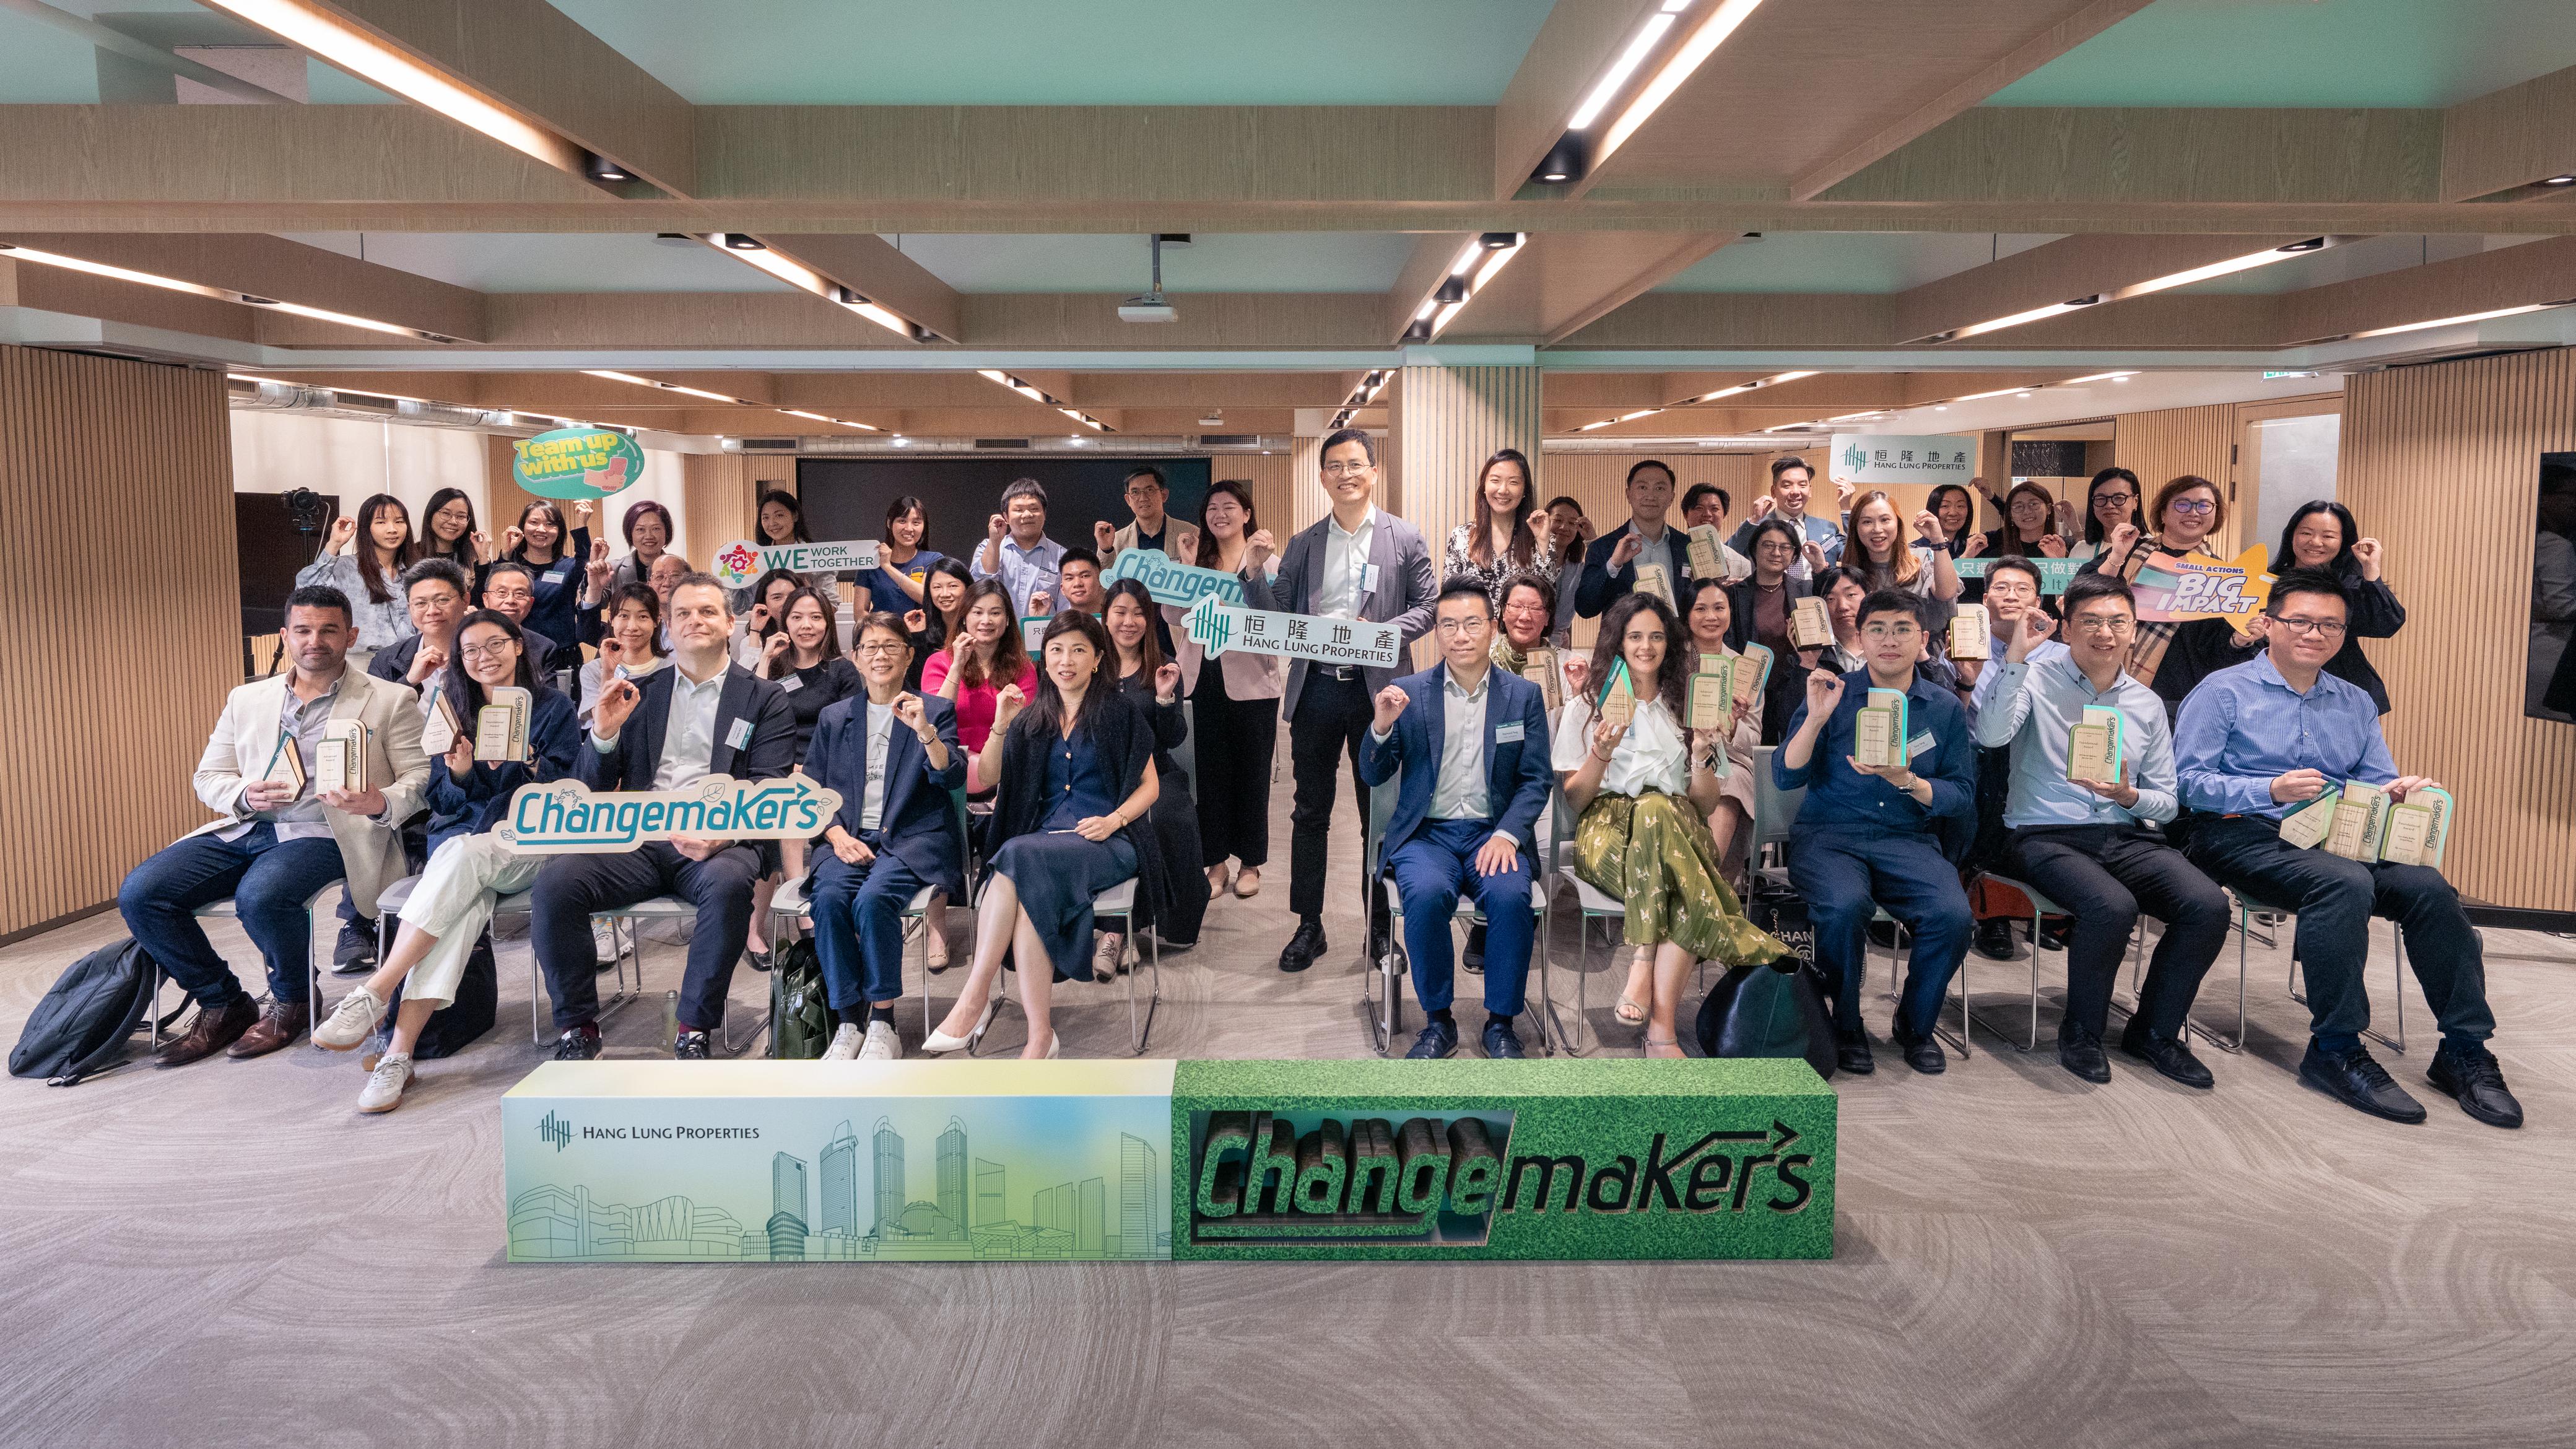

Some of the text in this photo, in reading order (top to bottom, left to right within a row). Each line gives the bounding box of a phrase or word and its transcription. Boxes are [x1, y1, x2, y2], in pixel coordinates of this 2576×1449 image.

[515, 433, 618, 459] Team up
[1874, 450, 1967, 463] 恒隆地產
[518, 452, 609, 476] with us
[1922, 462, 1966, 470] PROPERTIES
[764, 546, 847, 570] WE WORK
[811, 557, 873, 568] TOGETHER
[2175, 562, 2244, 574] SMALL ACTIONS
[2175, 573, 2248, 599] BIG
[2156, 593, 2260, 613] IMPACT
[1244, 614, 1395, 650] 恒隆地產
[1243, 635, 1393, 663] HANG LUNG PROPERTIES
[1718, 664, 1728, 713] Changemakers
[511, 695, 524, 743] Changemakers
[1891, 698, 1900, 748] Changemakers
[349, 728, 359, 775] Changemakers
[2105, 716, 2116, 765] Changemakers
[516, 785, 819, 846] Changemakers
[2362, 795, 2381, 845] Changemakers
[2425, 799, 2443, 850] Changemakers
[583, 1126, 760, 1139] HANG LUNG PROPERTIES
[1196, 1124, 1814, 1237] Changemakers
